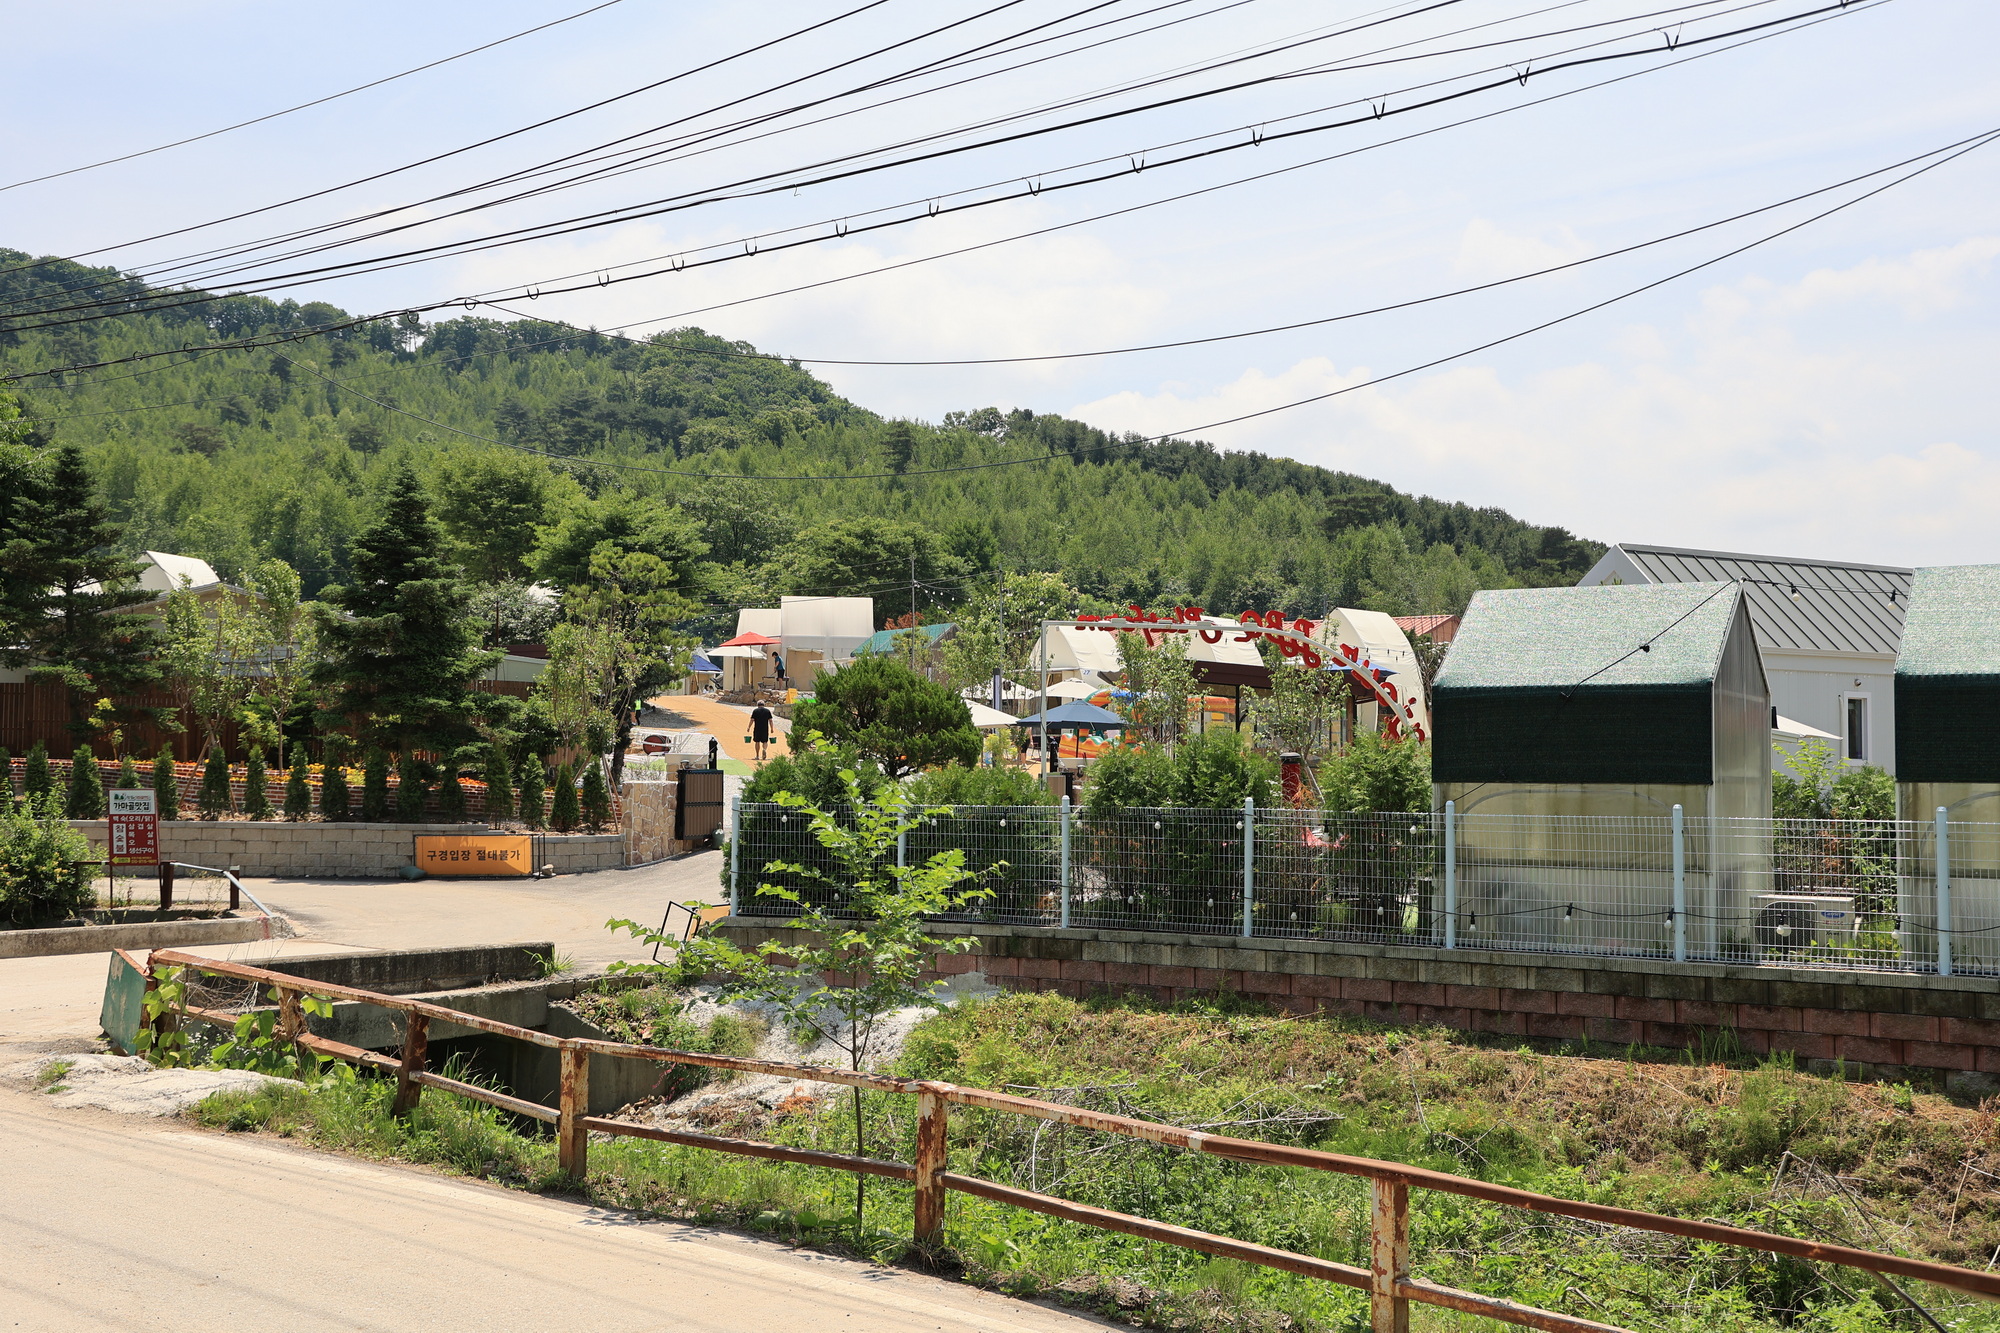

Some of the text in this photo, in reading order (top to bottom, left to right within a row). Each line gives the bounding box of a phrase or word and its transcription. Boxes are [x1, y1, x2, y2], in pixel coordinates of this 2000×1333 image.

[113, 801, 150, 811] 가마골맛집
[426, 849, 521, 861] 구경입장 절대불가
